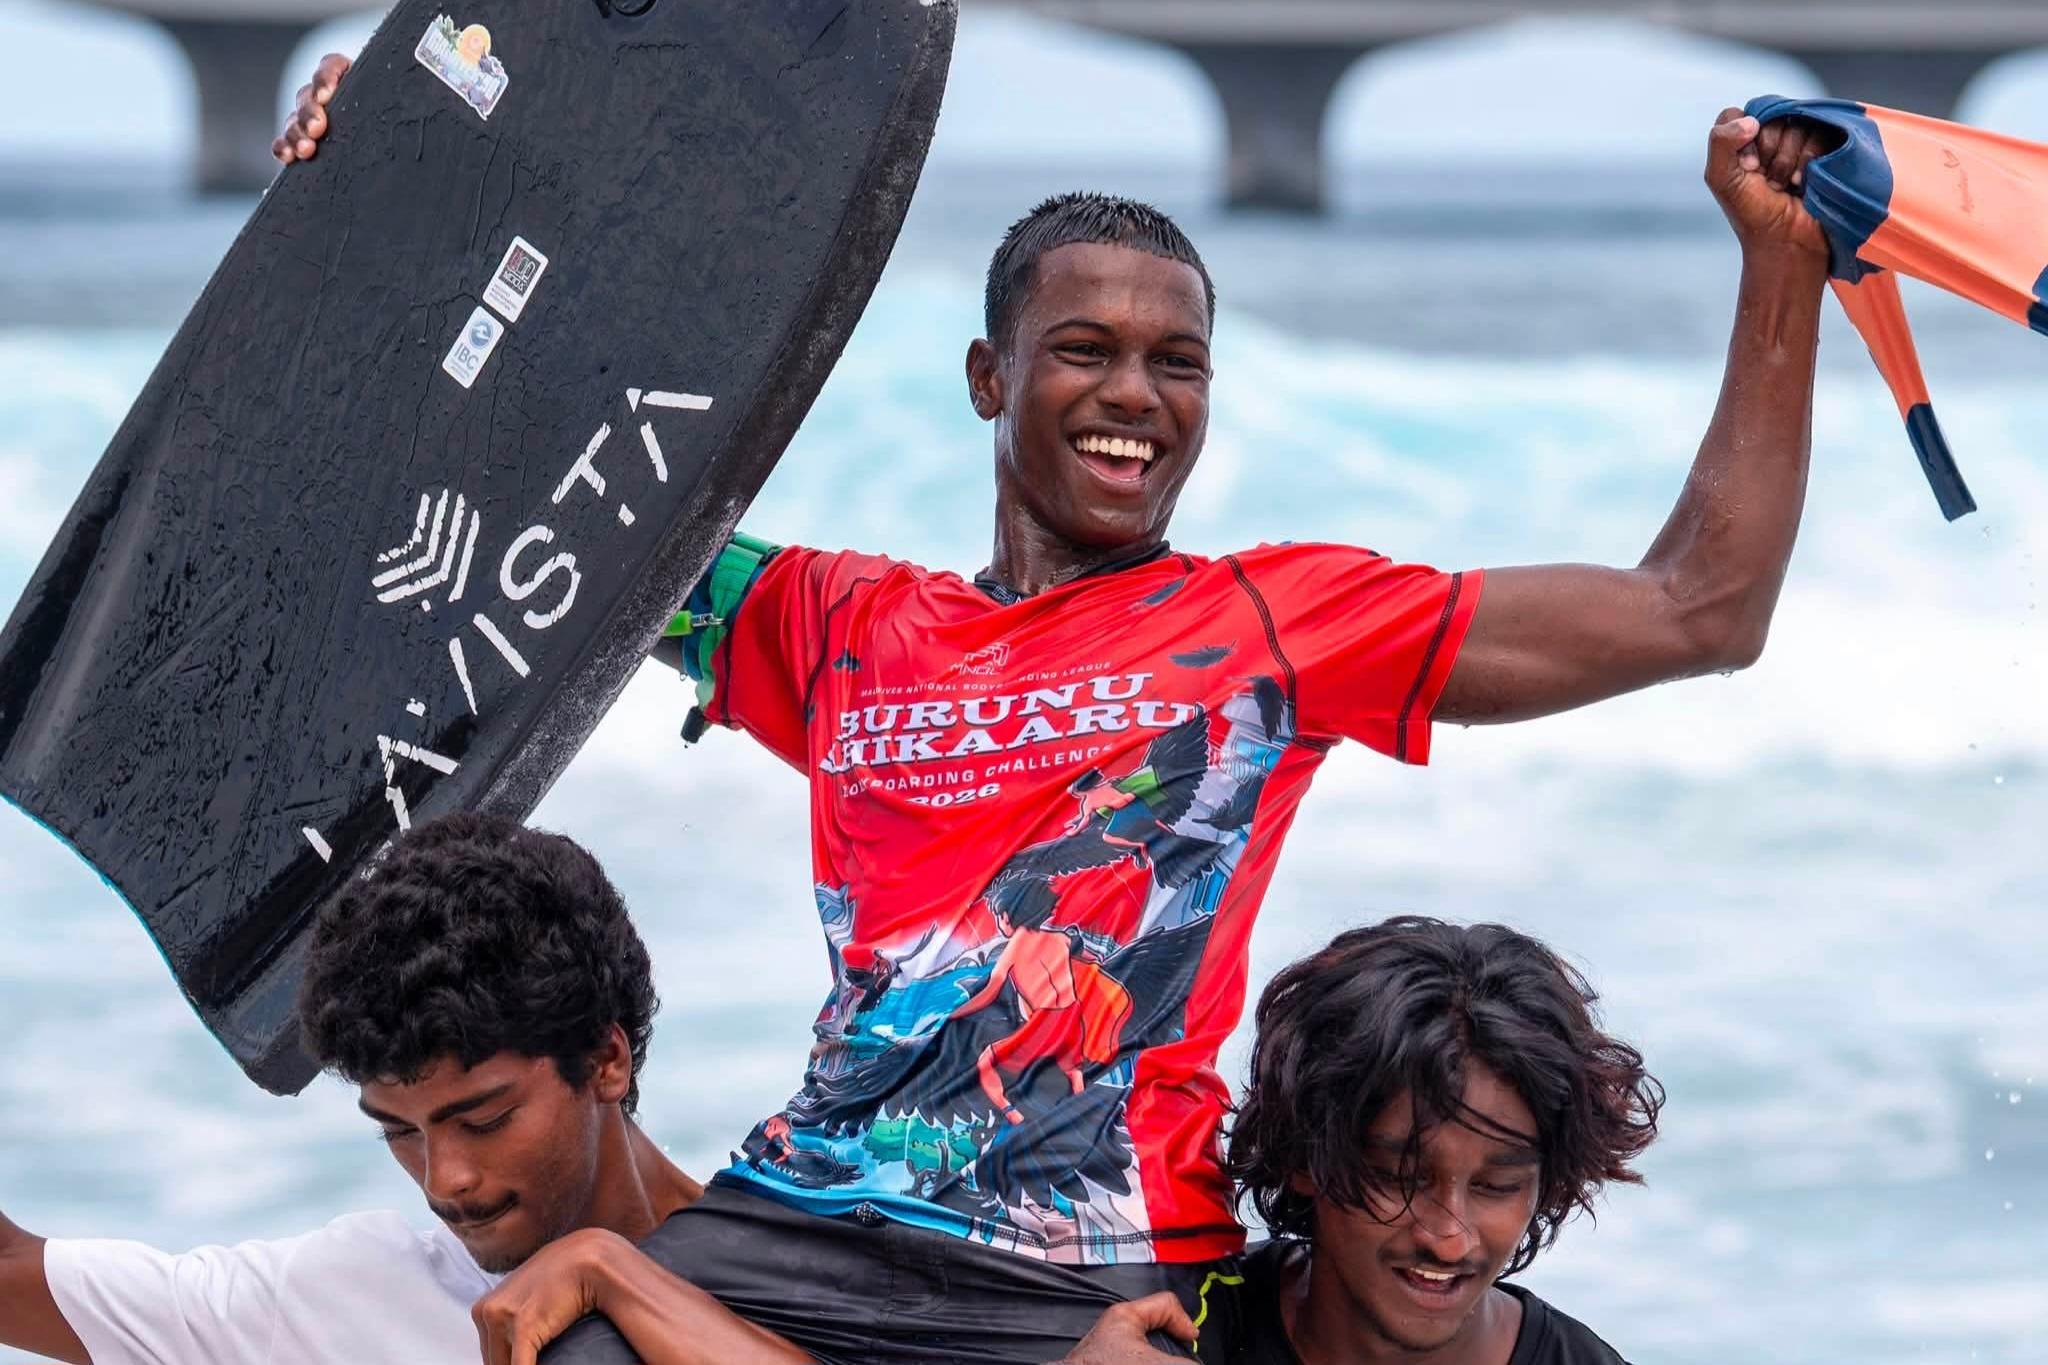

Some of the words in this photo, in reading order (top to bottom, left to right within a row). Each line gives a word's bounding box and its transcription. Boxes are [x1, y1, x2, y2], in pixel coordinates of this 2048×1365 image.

[454, 343, 479, 370] IBC
[905, 682, 957, 695] NATIONAL
[963, 672, 1057, 691] BODYDING
[1062, 661, 1112, 677] LEAGUE
[836, 672, 1154, 741] BURUNU
